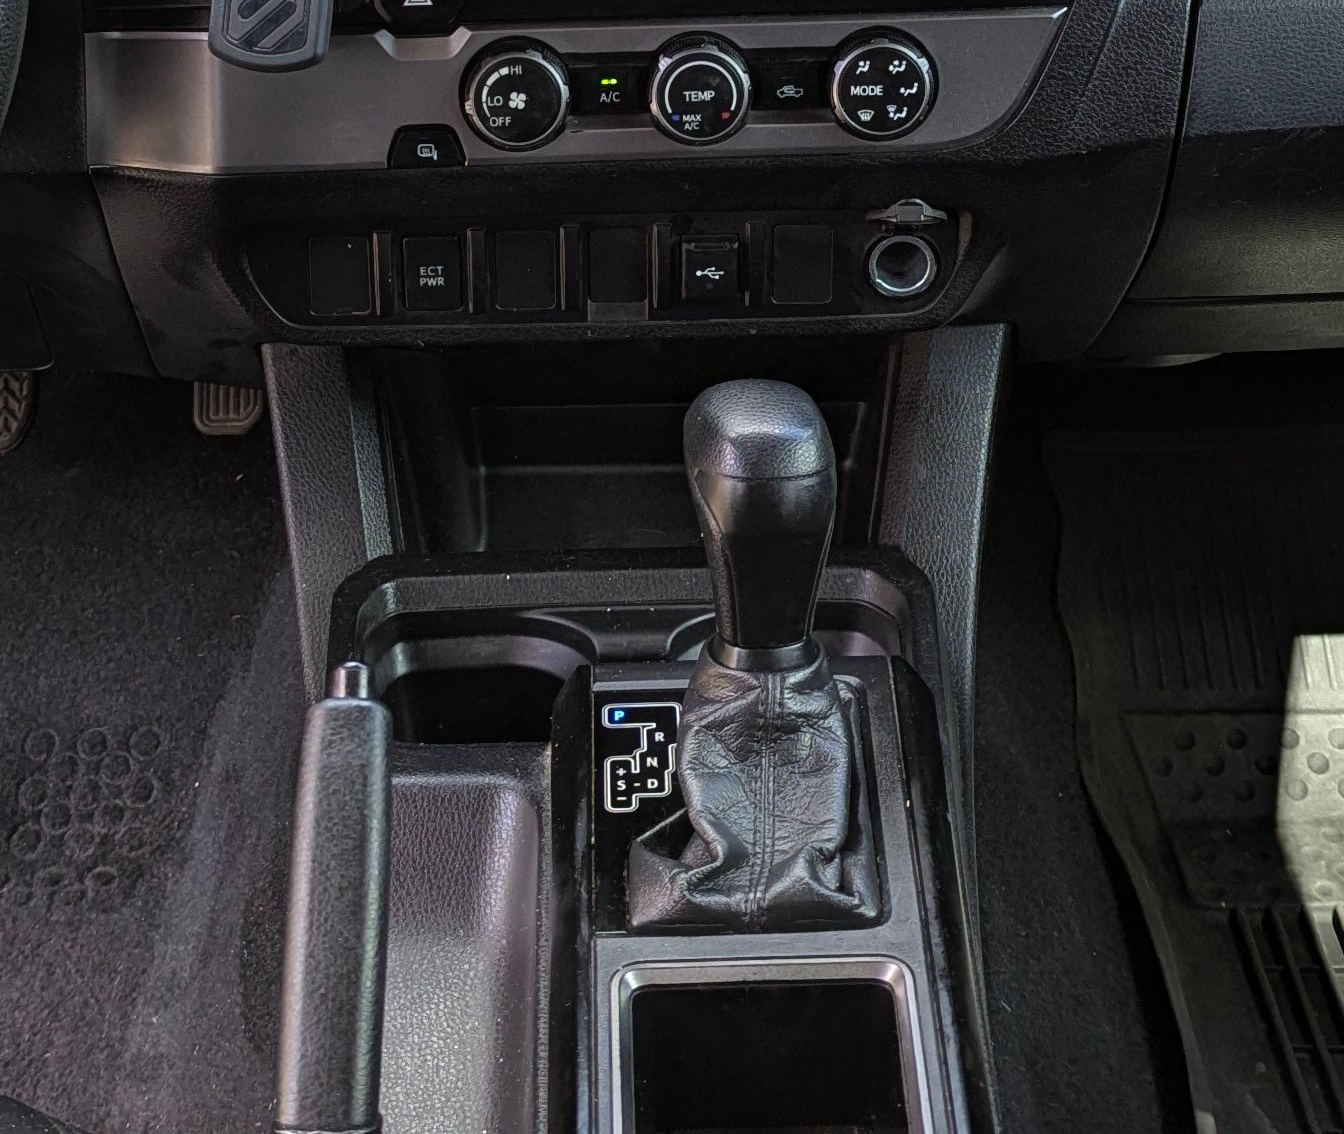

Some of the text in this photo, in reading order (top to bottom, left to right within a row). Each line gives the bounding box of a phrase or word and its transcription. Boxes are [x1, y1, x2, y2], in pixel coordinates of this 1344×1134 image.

[510, 66, 522, 75] HI
[850, 85, 883, 96] MODE
[487, 96, 503, 106] LO
[600, 93, 620, 103] A/C
[683, 91, 715, 102] TEMP
[490, 116, 511, 127] OFF
[682, 114, 702, 122] MAX
[684, 122, 699, 130] A/C
[420, 266, 443, 276] ECT
[420, 277, 445, 286] PWR
[614, 710, 625, 721] P
[655, 731, 665, 742] R
[646, 756, 658, 768] N
[617, 780, 626, 790] S
[647, 779, 659, 789] D
